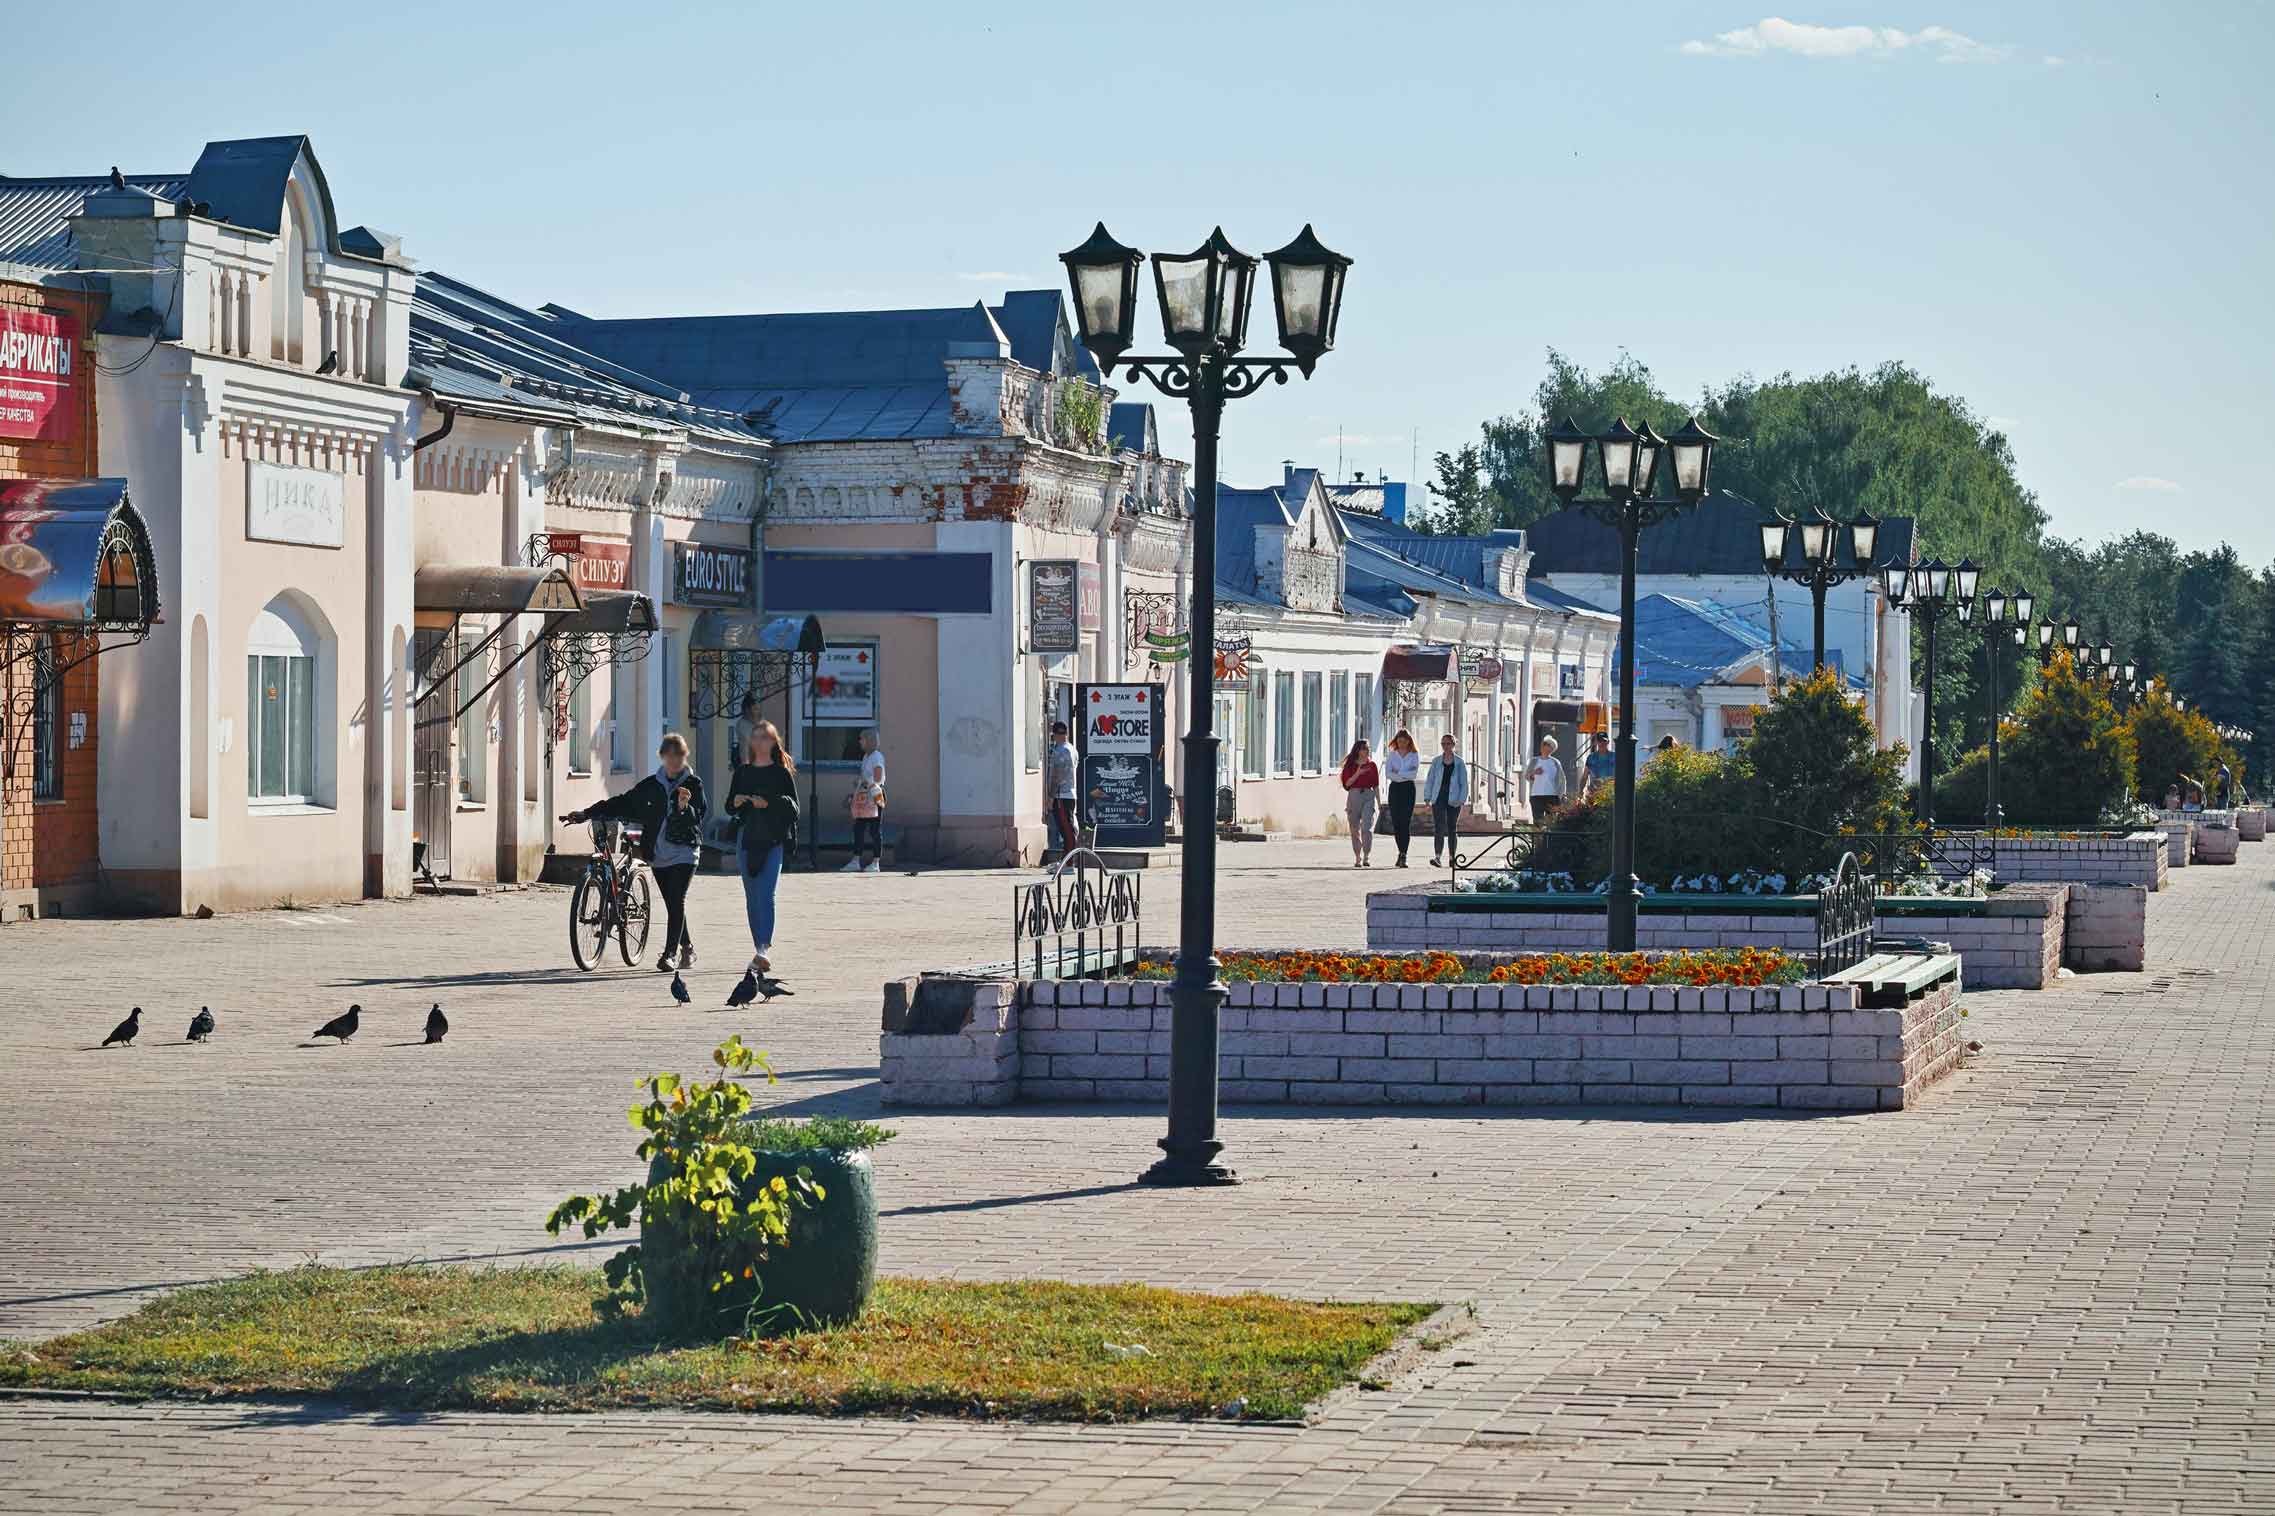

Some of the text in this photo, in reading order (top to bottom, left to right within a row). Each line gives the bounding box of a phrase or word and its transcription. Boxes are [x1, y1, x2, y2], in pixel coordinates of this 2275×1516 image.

[0, 331, 71, 375] АБРИКАТЫ
[7, 408, 34, 423] КАЧЕСТВА
[552, 539, 576, 550] СИЛУЭТ
[580, 558, 625, 584] СИЛУЭТ
[685, 550, 745, 593] EURO STYLE
